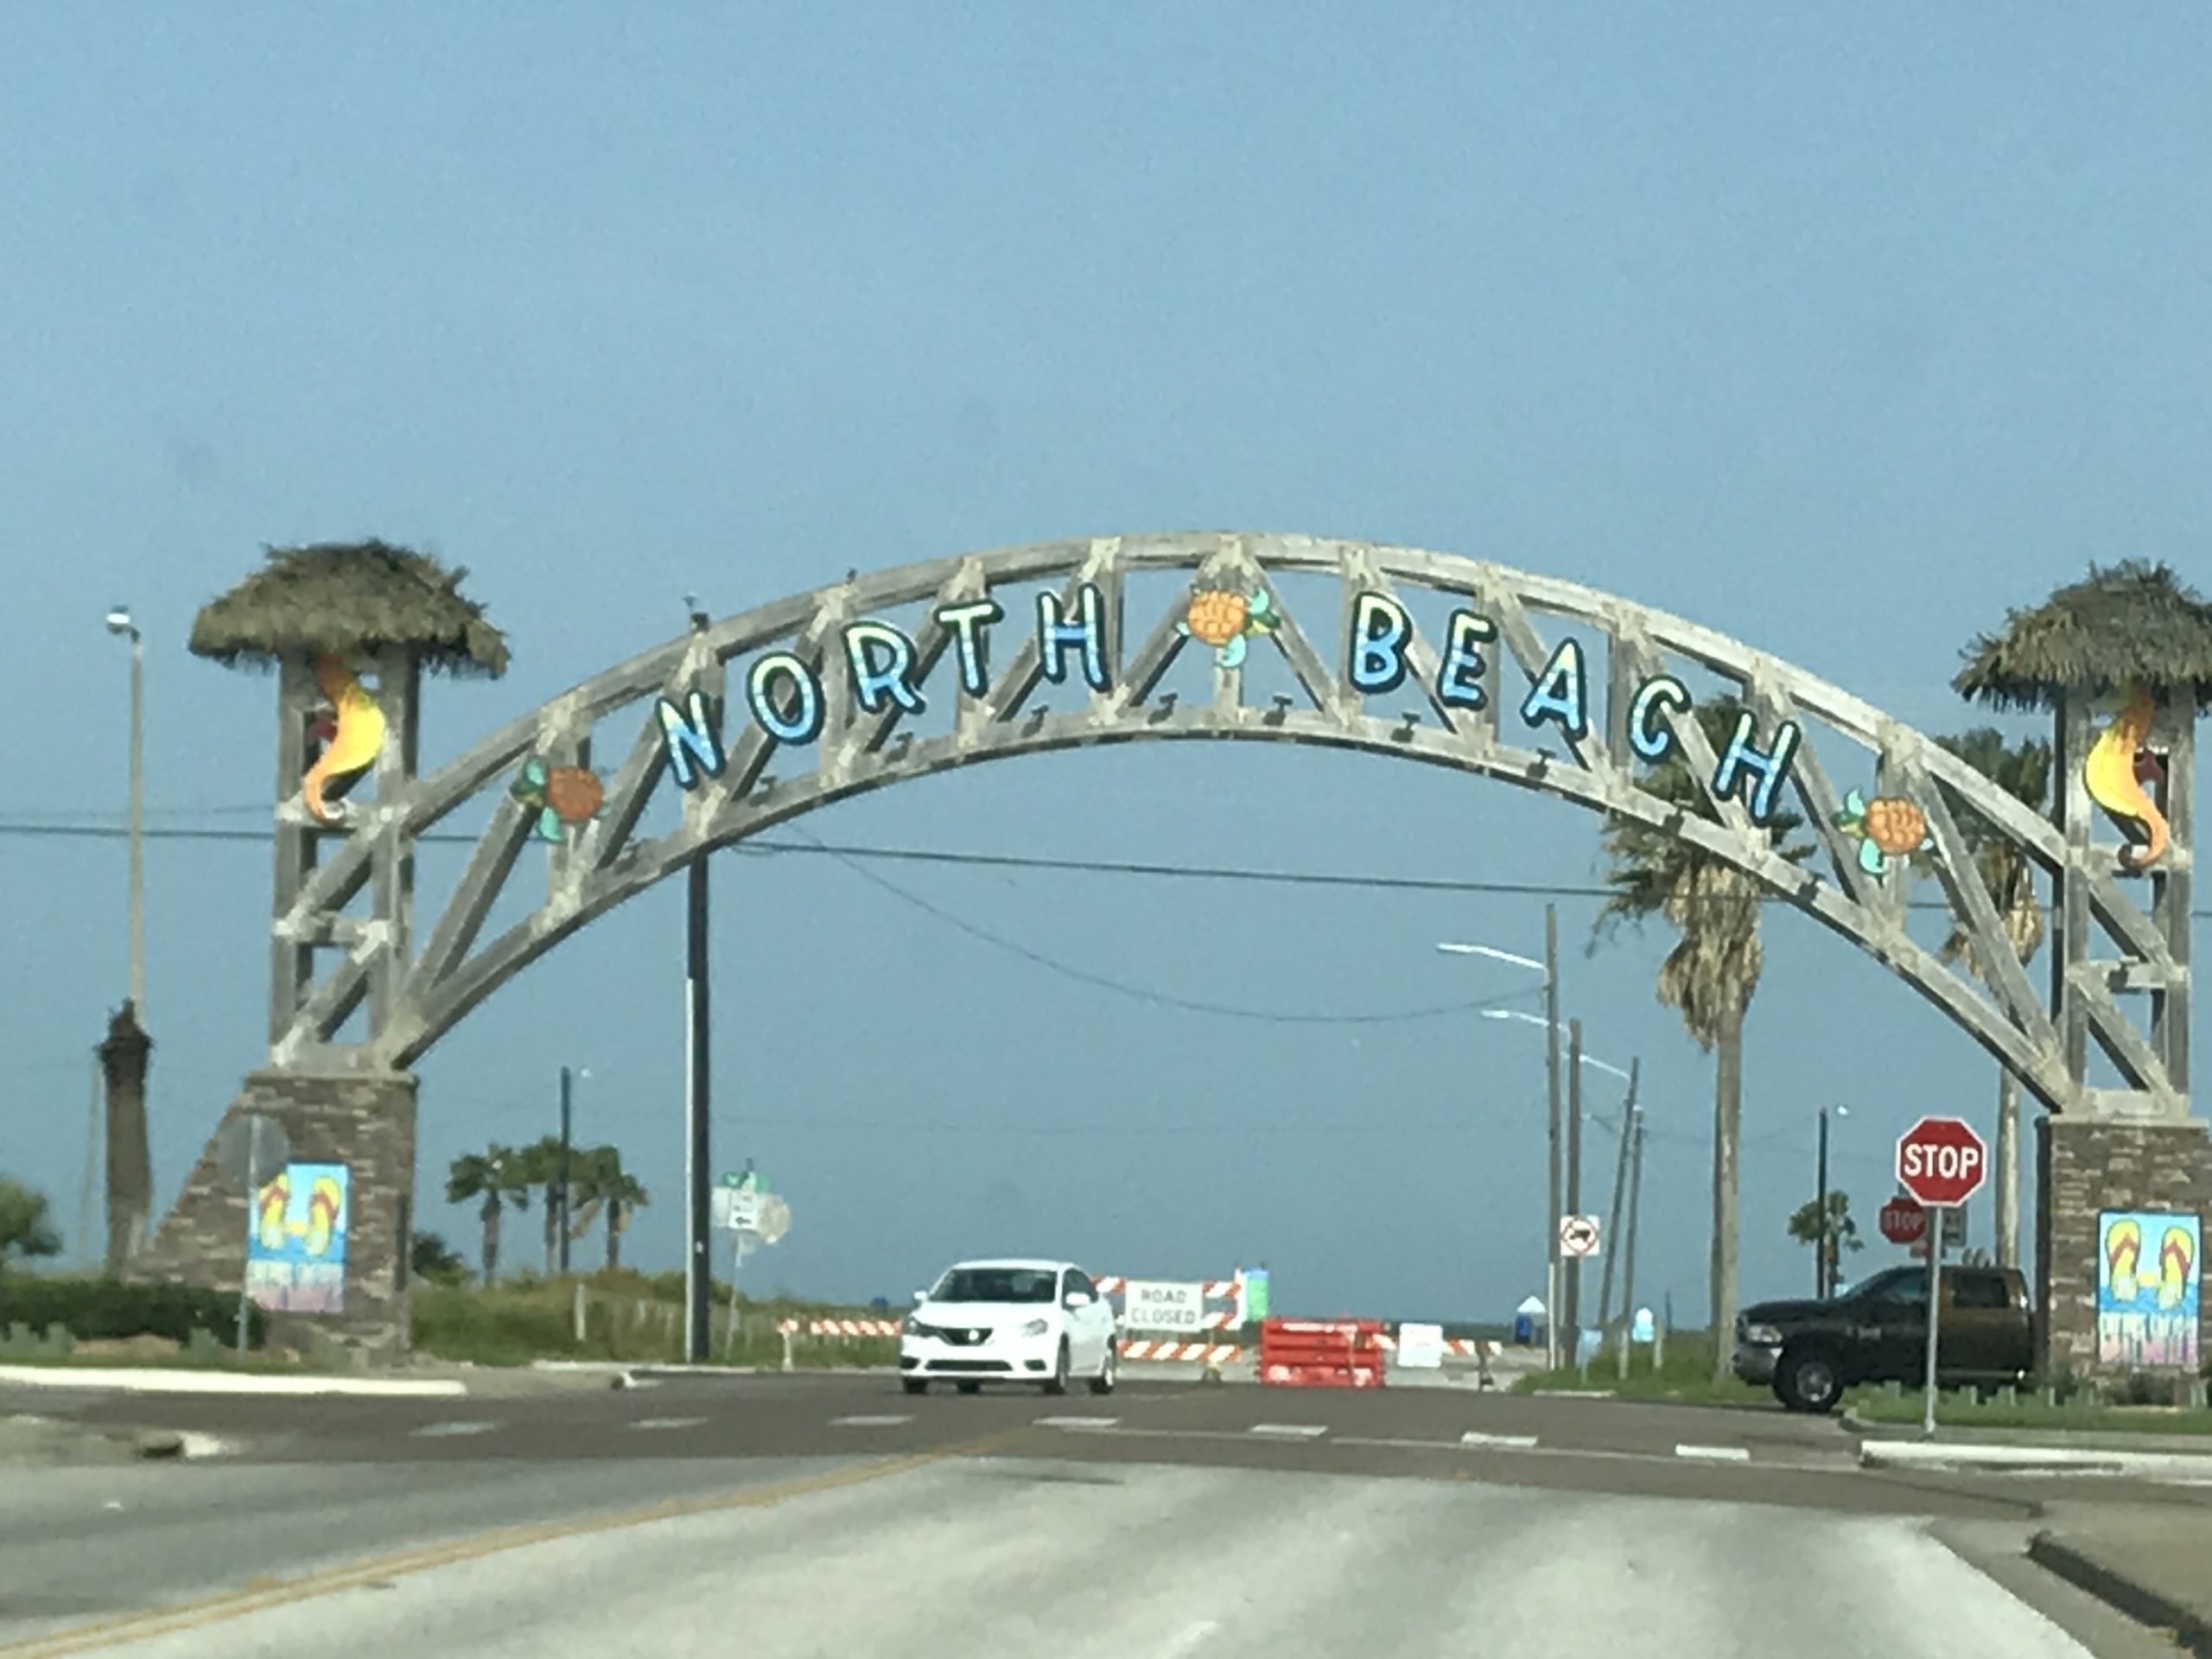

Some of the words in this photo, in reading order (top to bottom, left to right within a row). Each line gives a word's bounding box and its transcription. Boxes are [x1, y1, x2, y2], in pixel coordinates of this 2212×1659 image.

[655, 583, 1113, 788] NORTH
[1347, 591, 1801, 826] BEACH
[1904, 1143, 1979, 1179] STOP
[1884, 1210, 1923, 1232] STOP
[1141, 1288, 1187, 1304] ROAD
[1130, 1307, 1197, 1325] CLOSED
